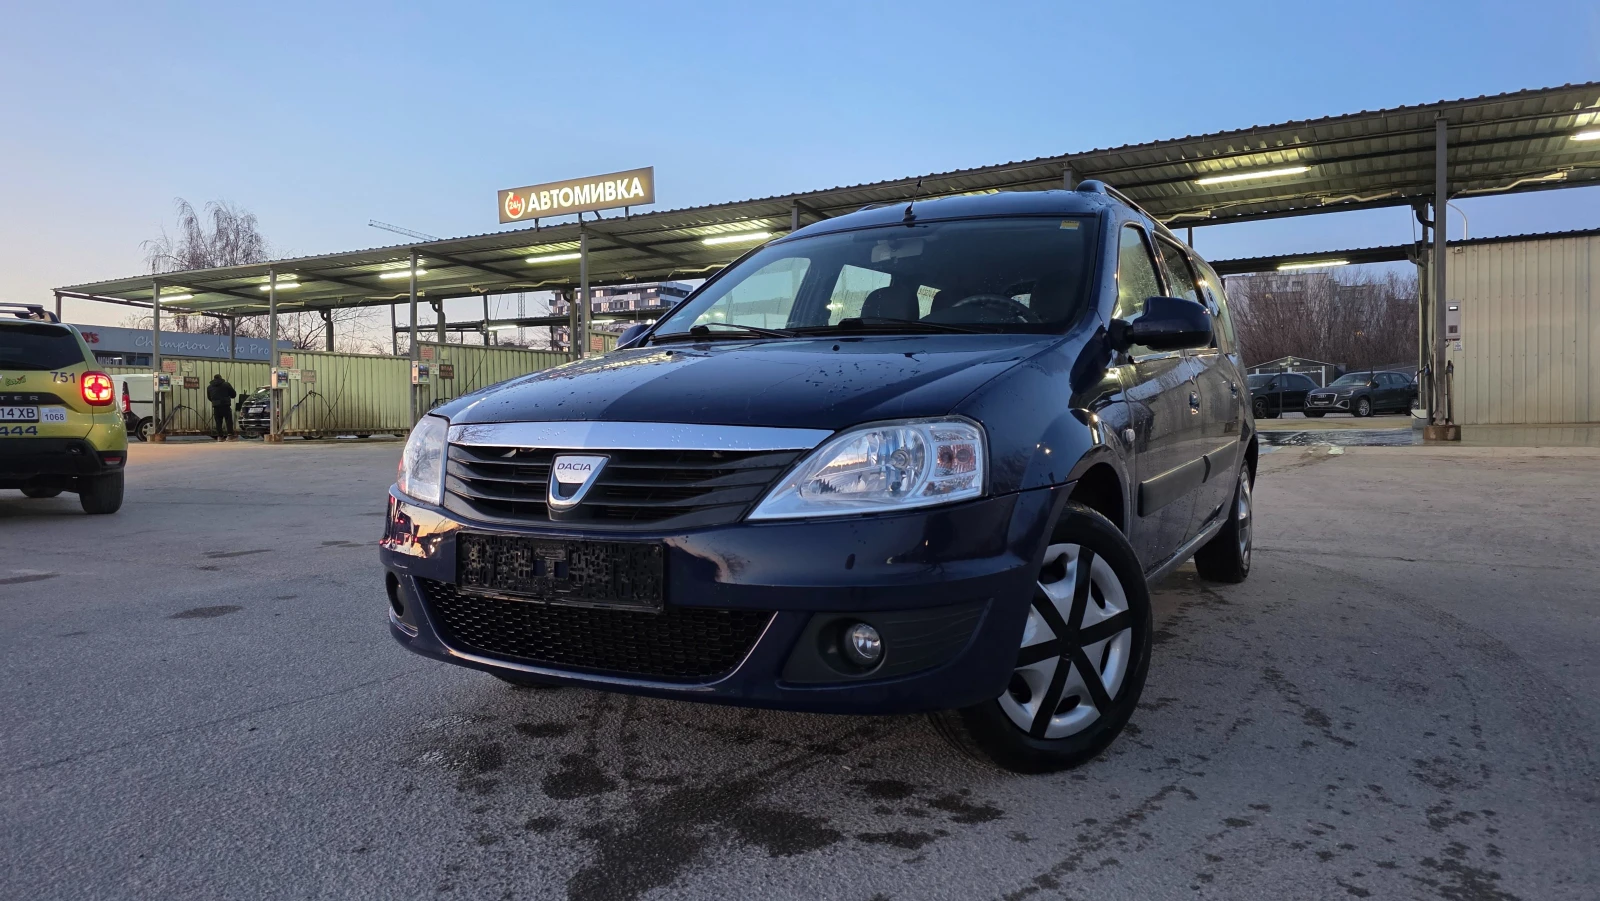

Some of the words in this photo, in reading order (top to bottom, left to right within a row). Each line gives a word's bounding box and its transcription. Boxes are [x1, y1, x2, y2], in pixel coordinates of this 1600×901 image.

[527, 177, 644, 213] АВТОМИВКА
[135, 336, 210, 352] Chmpion
[249, 343, 269, 355] Pro
[50, 372, 76, 383] 751
[45, 413, 65, 421] 1068
[557, 463, 592, 471] DACIA
